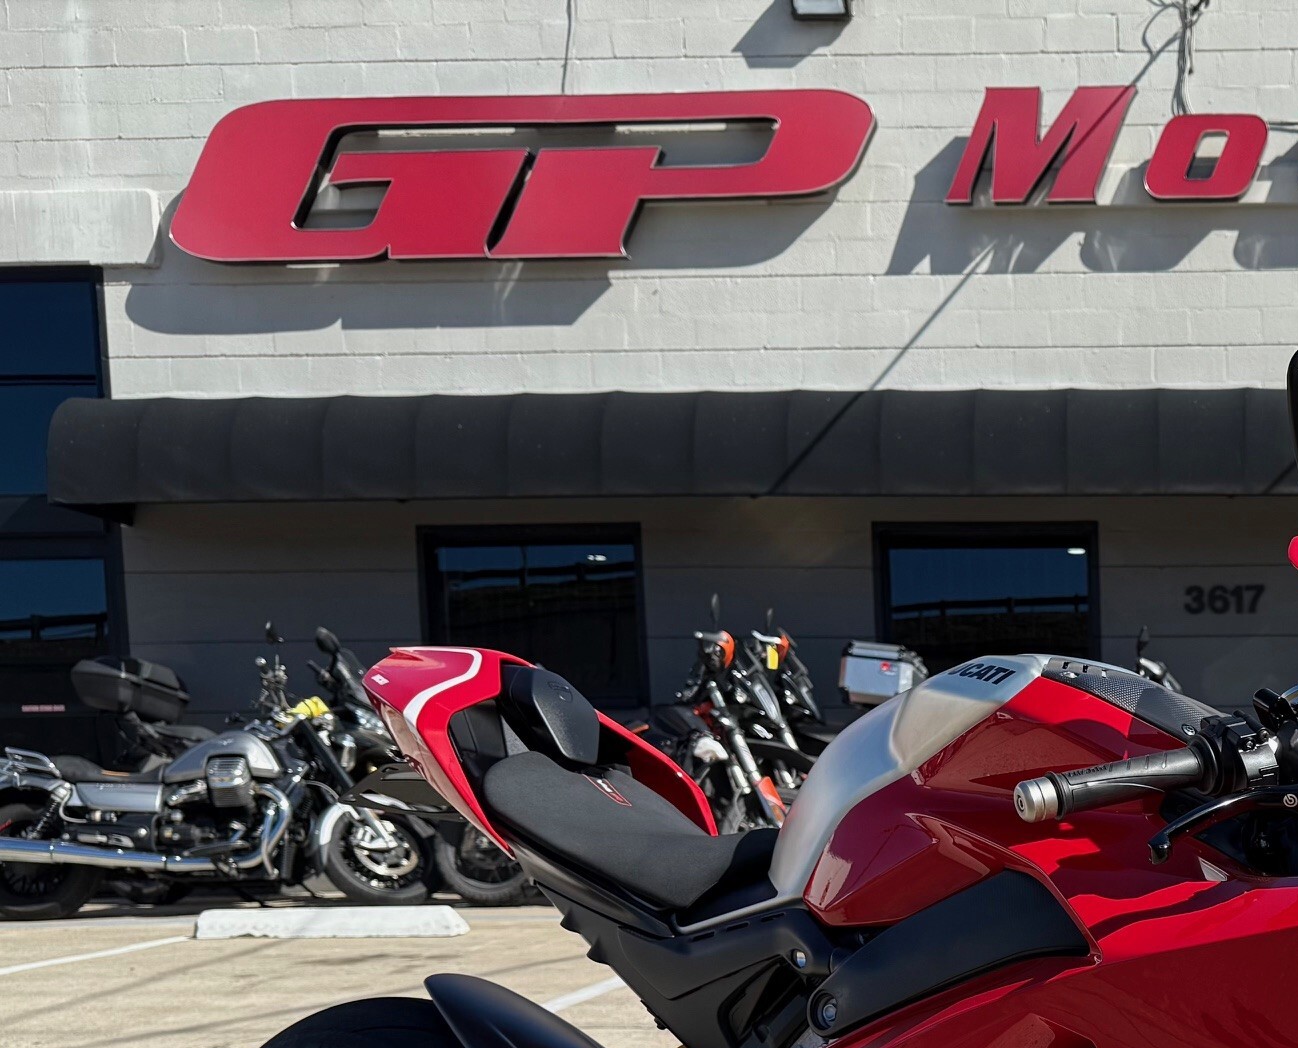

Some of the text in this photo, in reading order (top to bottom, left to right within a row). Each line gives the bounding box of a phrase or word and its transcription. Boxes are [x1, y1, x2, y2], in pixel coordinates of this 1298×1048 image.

[169, 88, 877, 264] GP
[1184, 584, 1266, 615] 3617
[948, 662, 1017, 686] UCATI
